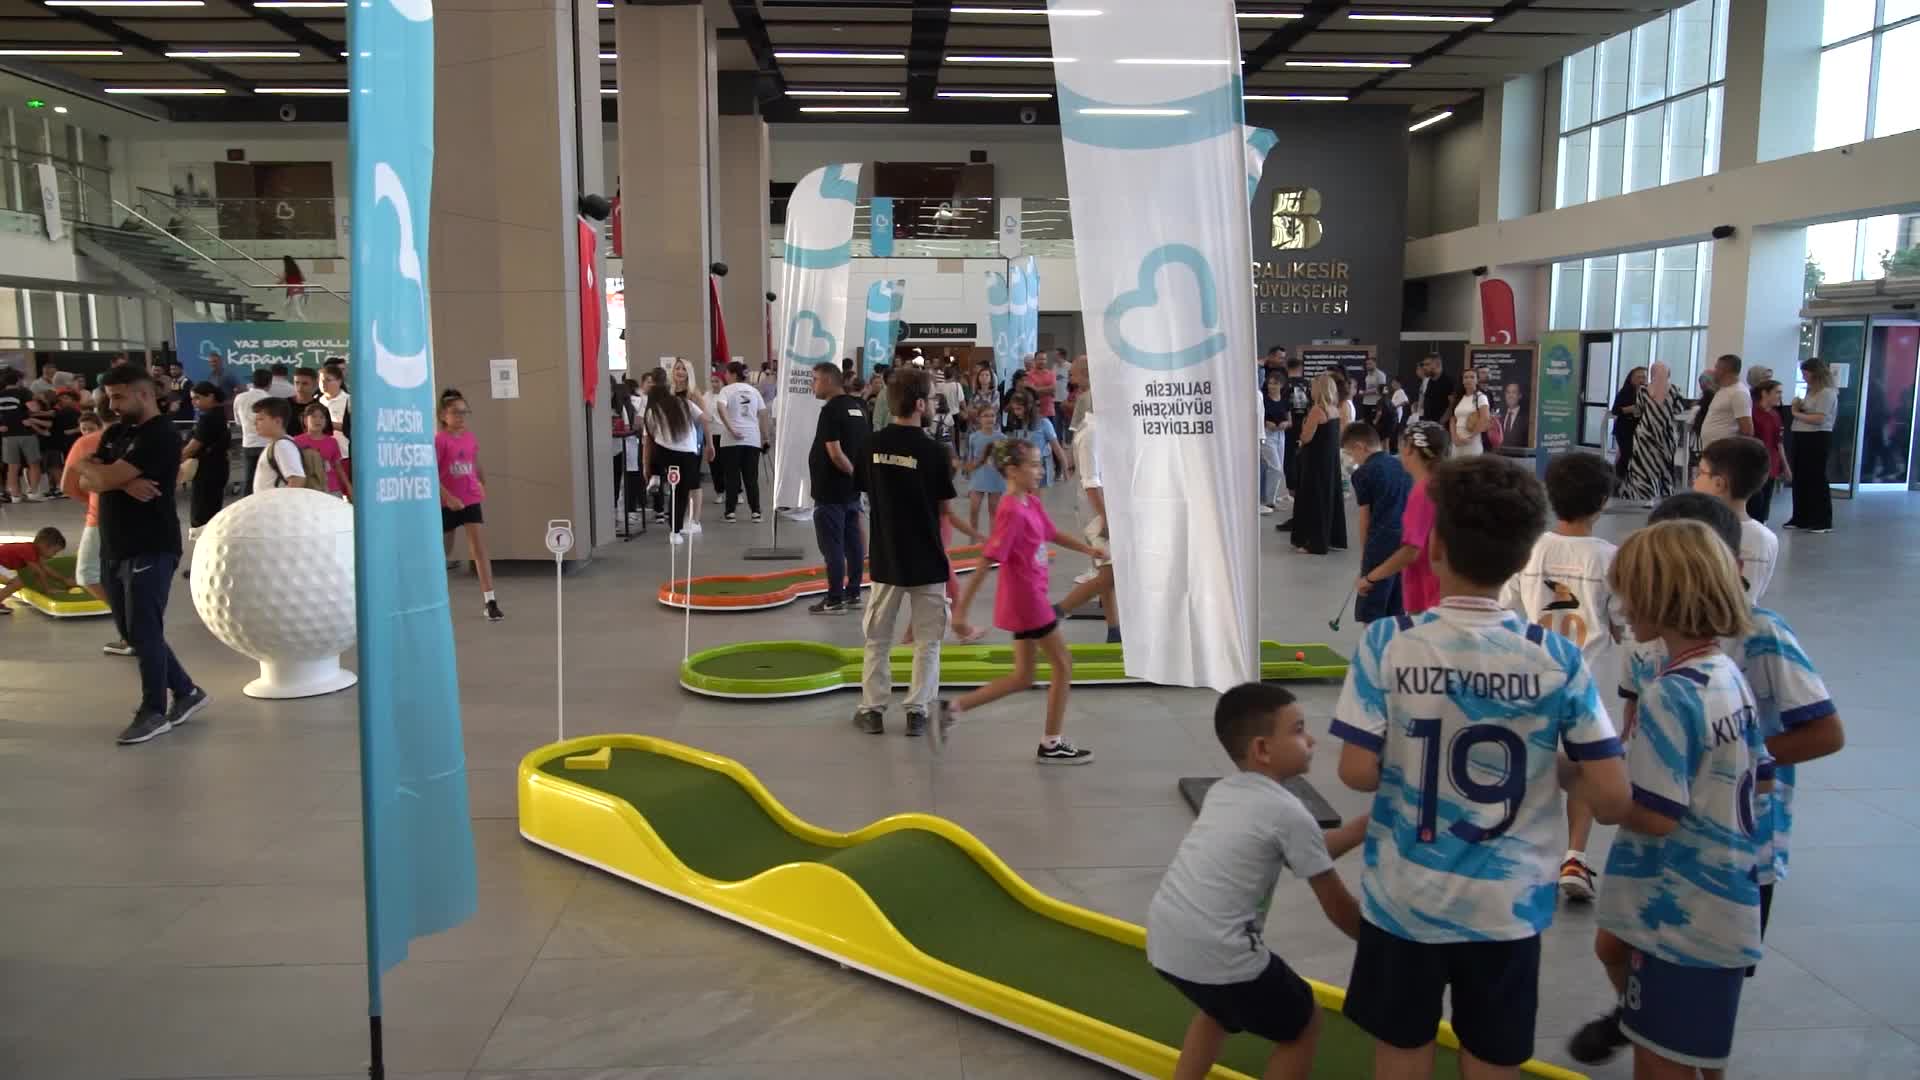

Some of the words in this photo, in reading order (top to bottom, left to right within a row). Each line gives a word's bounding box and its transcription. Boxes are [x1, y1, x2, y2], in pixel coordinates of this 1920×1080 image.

[1259, 299, 1348, 315] ELEDİYESİ
[234, 339, 260, 348] YAZ
[262, 339, 298, 348] SPOR
[1395, 667, 1541, 700] KUZEYORDU
[1406, 718, 1527, 843] 19
